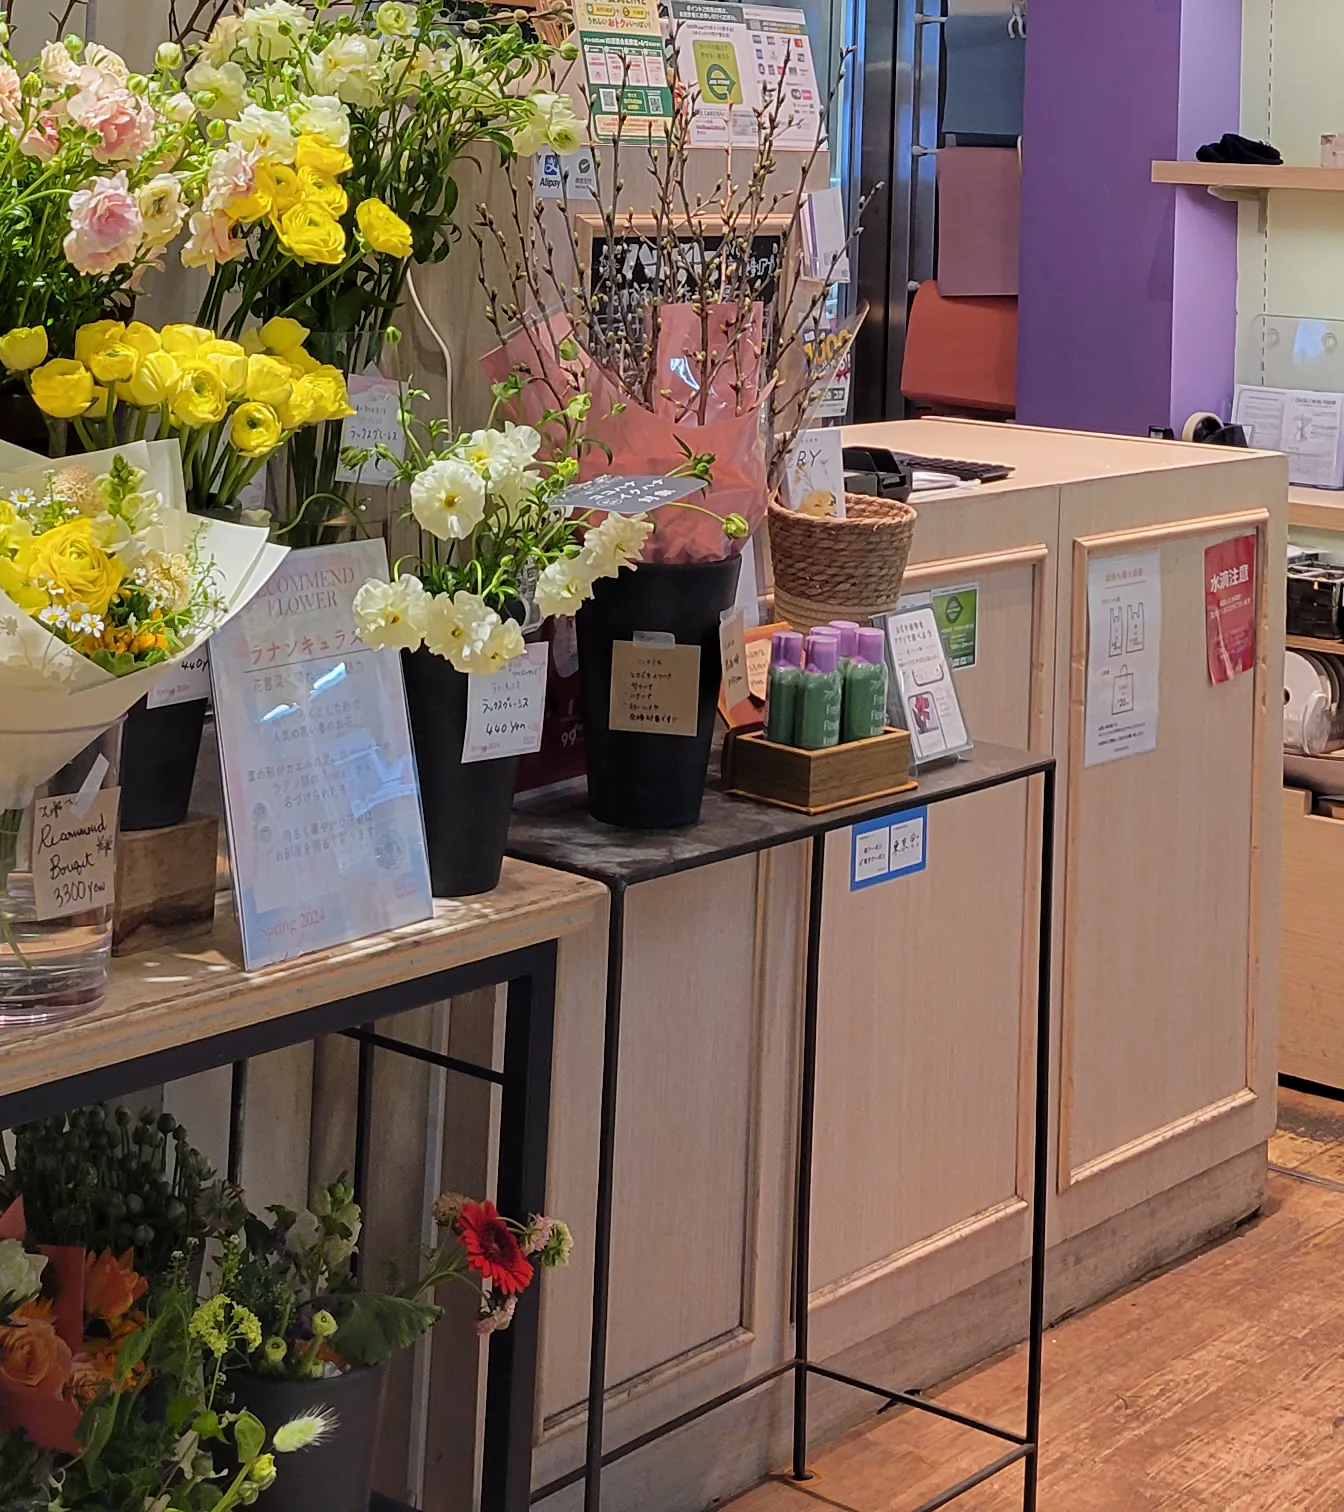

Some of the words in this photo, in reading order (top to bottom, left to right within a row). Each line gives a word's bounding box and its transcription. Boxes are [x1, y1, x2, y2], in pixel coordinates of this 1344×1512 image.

[540, 176, 562, 189] Alipay
[258, 567, 355, 599] COMMEND
[1210, 564, 1249, 593] 水滴注意
[267, 590, 338, 617] FLOWER
